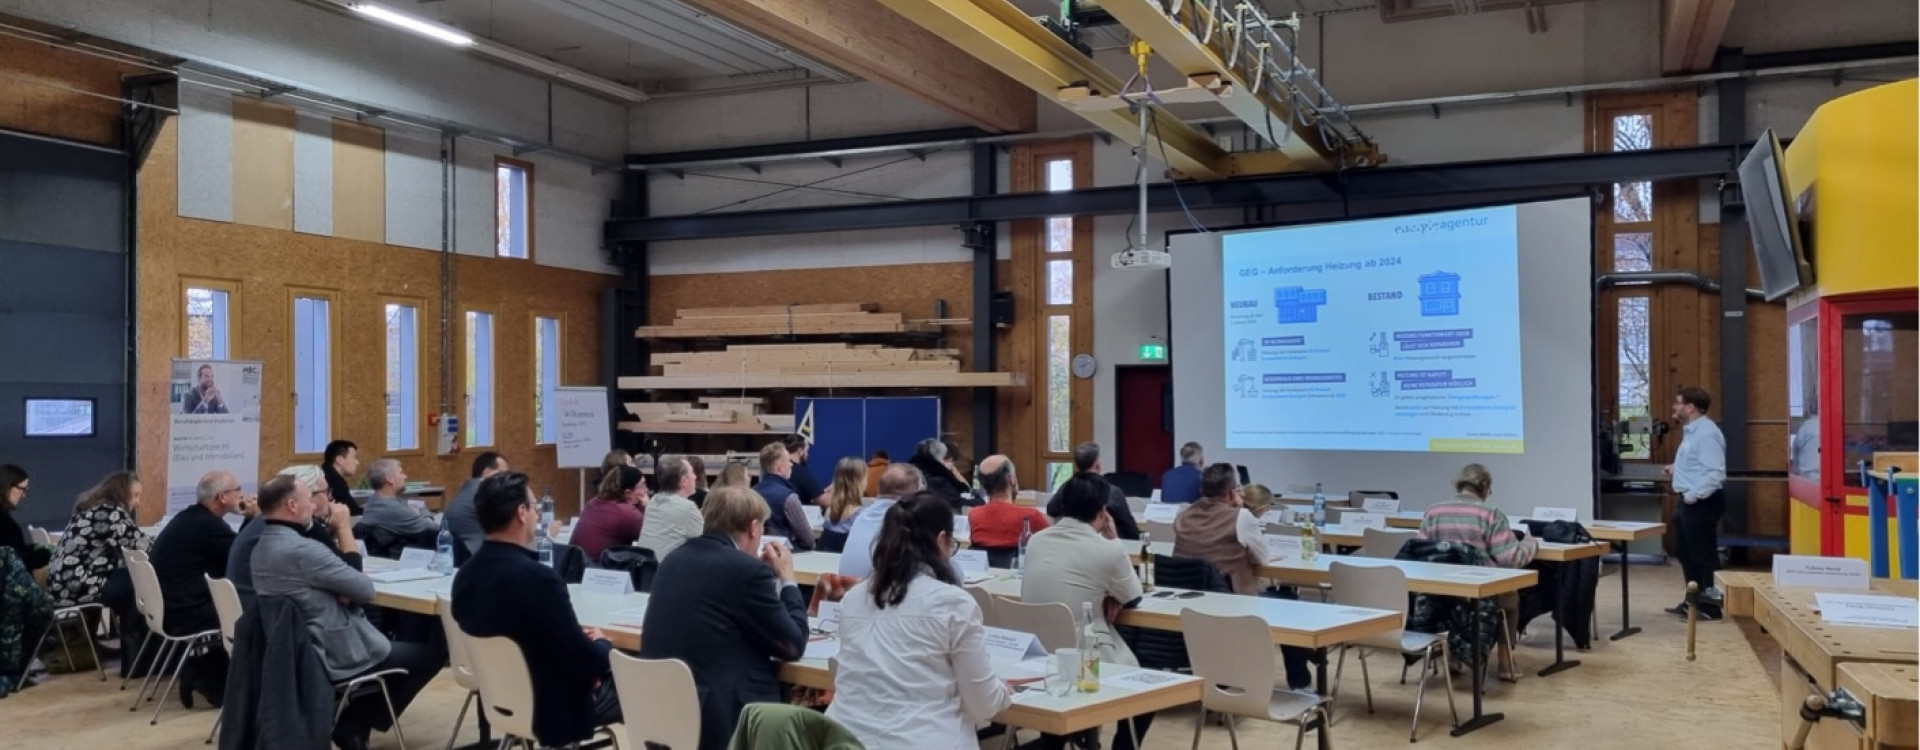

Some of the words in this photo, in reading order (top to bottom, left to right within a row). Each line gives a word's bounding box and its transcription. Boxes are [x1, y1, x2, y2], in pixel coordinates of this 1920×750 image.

[1239, 268, 1259, 277] GEG
[1268, 263, 1323, 275] Anforderung
[1325, 260, 1361, 272] Heizung
[1365, 258, 1377, 268] ab
[1379, 256, 1402, 267] 2024
[1367, 291, 1403, 301] BESTAND
